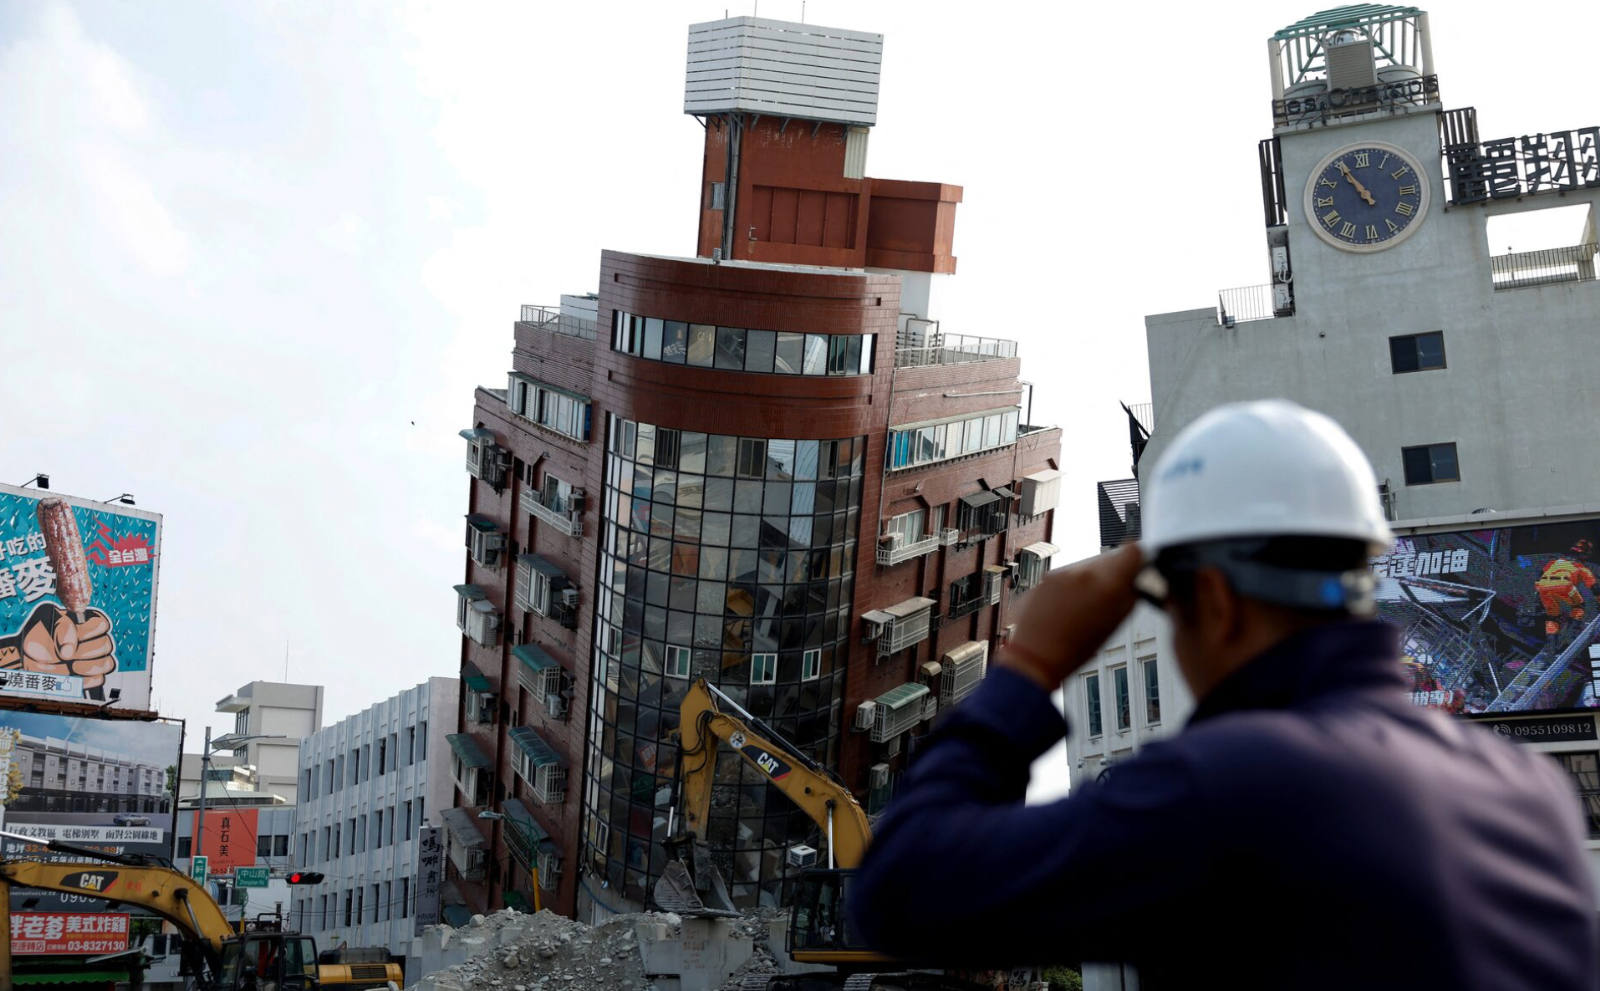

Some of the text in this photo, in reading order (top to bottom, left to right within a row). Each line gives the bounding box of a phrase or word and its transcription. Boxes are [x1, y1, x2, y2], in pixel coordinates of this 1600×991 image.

[1355, 153, 1370, 168] XII
[1391, 166, 1408, 180] II
[1400, 185, 1415, 195] III
[109, 548, 149, 564] 全台灣
[0, 671, 57, 691] 燒番麥
[1514, 723, 1591, 736] 0955109812
[757, 752, 779, 774] CAT
[241, 869, 266, 878] 中山路
[79, 873, 105, 891] CAT
[68, 940, 125, 951] 03-8327130
